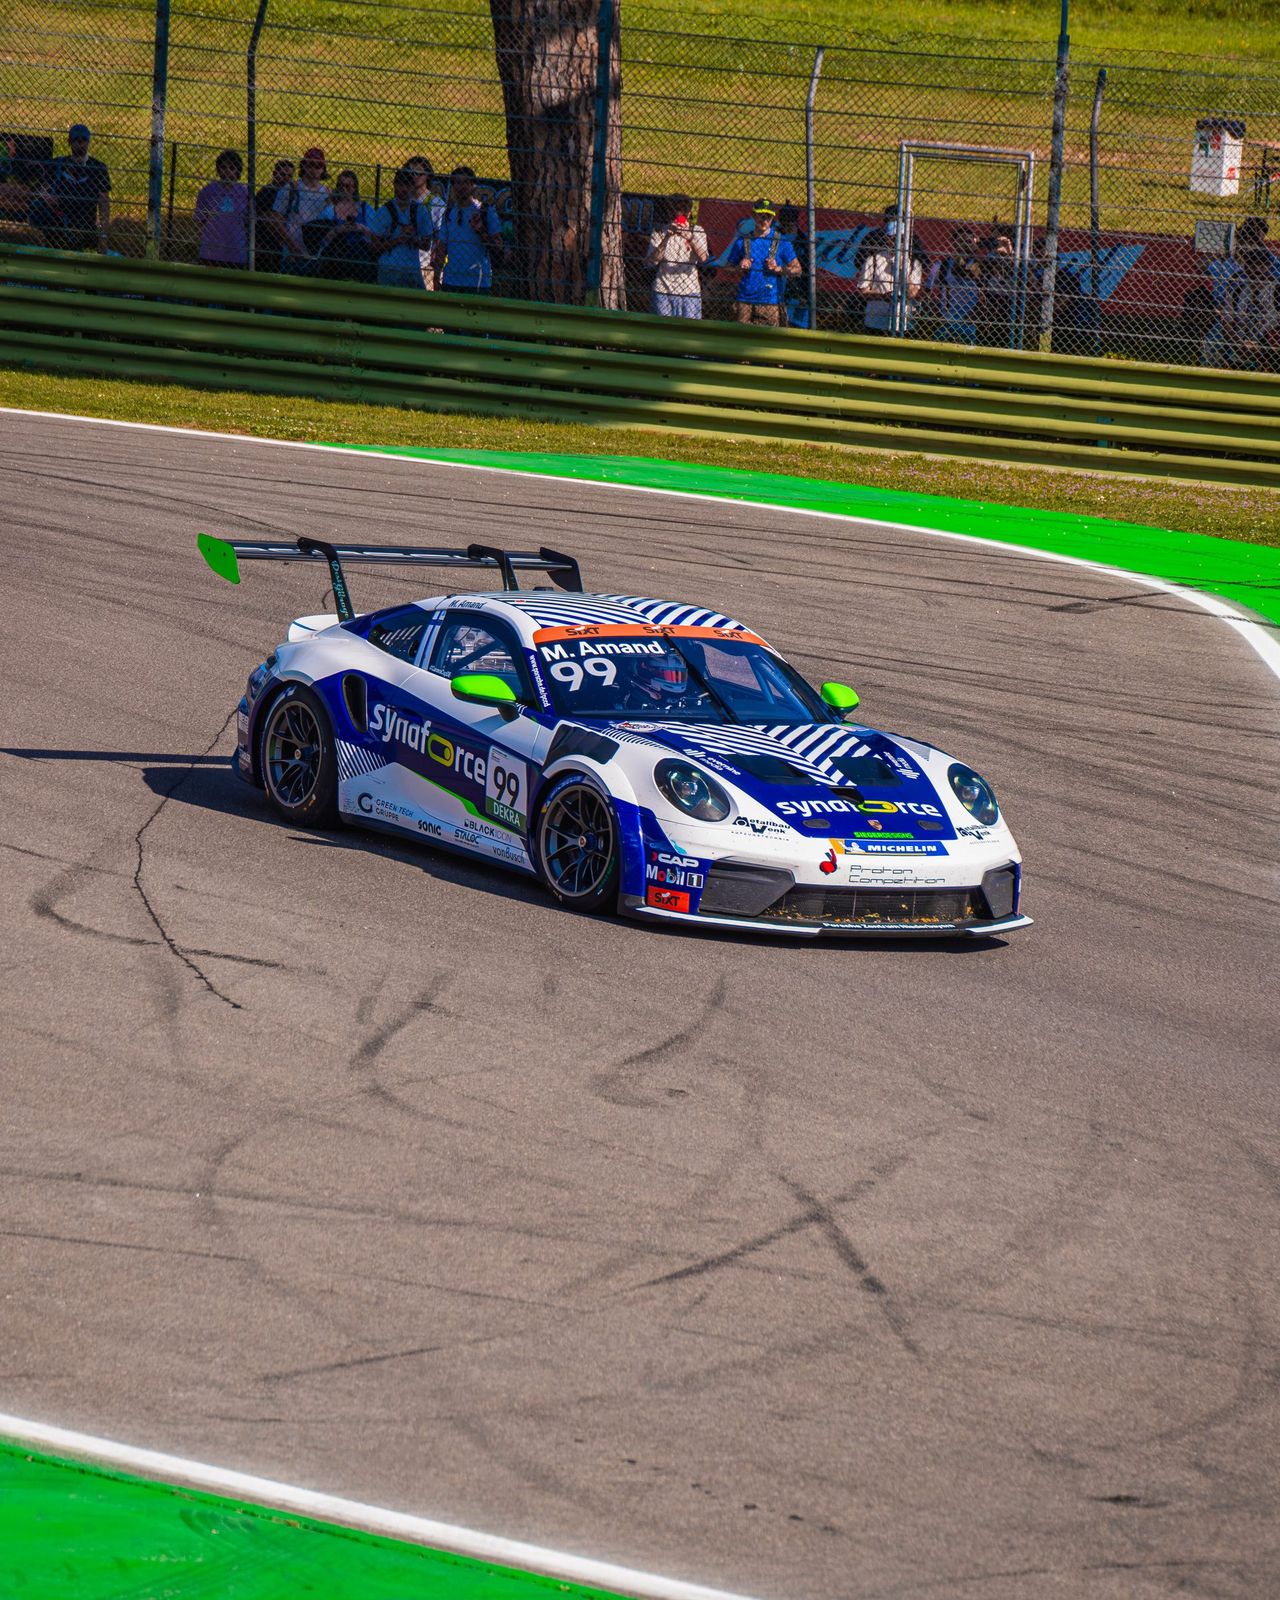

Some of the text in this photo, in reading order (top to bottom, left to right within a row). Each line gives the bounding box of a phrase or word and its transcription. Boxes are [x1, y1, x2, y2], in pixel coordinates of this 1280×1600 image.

[460, 600, 487, 609] Amand
[541, 641, 666, 662] M. Amand
[550, 657, 617, 692] 99
[493, 765, 520, 808] 99
[375, 808, 400, 822] GRUPPE
[376, 798, 414, 818] GREEN TECH
[493, 802, 521, 827] DEKRA
[454, 828, 482, 846] STALOC
[867, 844, 937, 852] MICHELIN
[658, 853, 700, 868] CAP
[850, 864, 913, 875] Proton
[646, 864, 685, 886] Mobil
[848, 874, 946, 885] Competition
